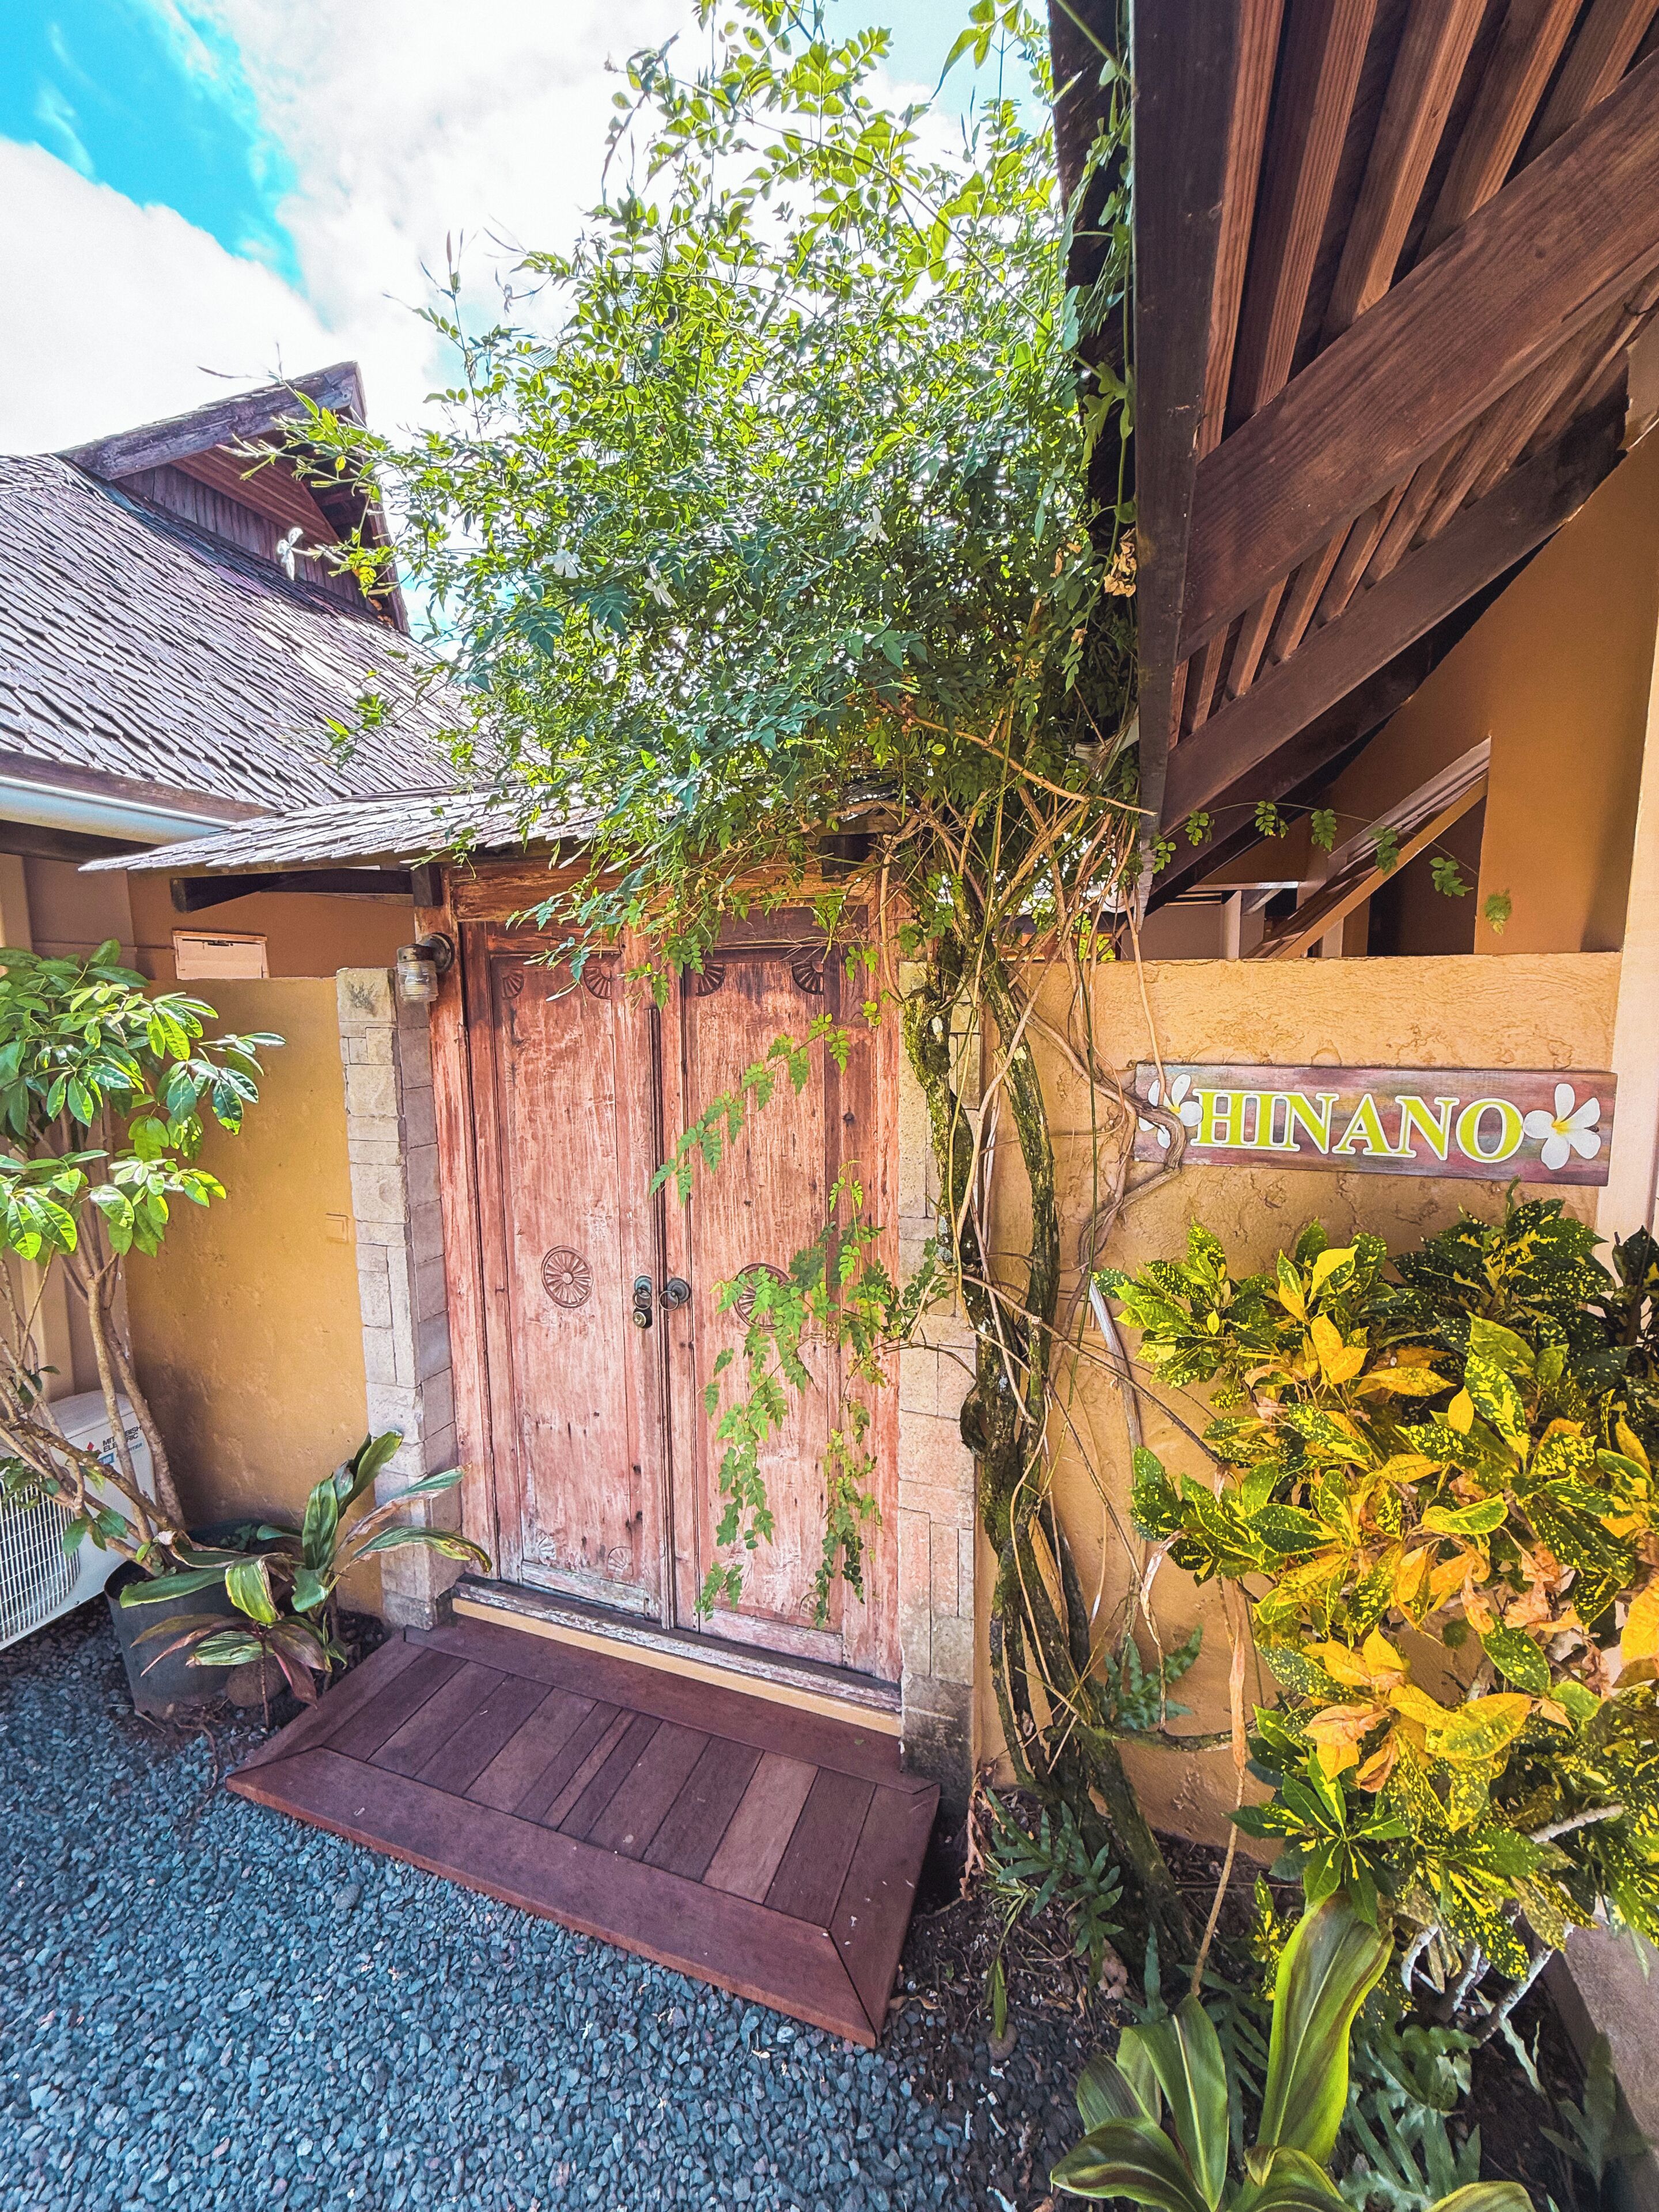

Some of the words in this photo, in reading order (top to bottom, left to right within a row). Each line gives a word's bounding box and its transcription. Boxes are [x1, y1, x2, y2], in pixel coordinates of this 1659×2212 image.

[1190, 1088, 1524, 1164] HINANO
[103, 1425, 142, 1446] MITBISH
[103, 1433, 139, 1453] ELERIC
